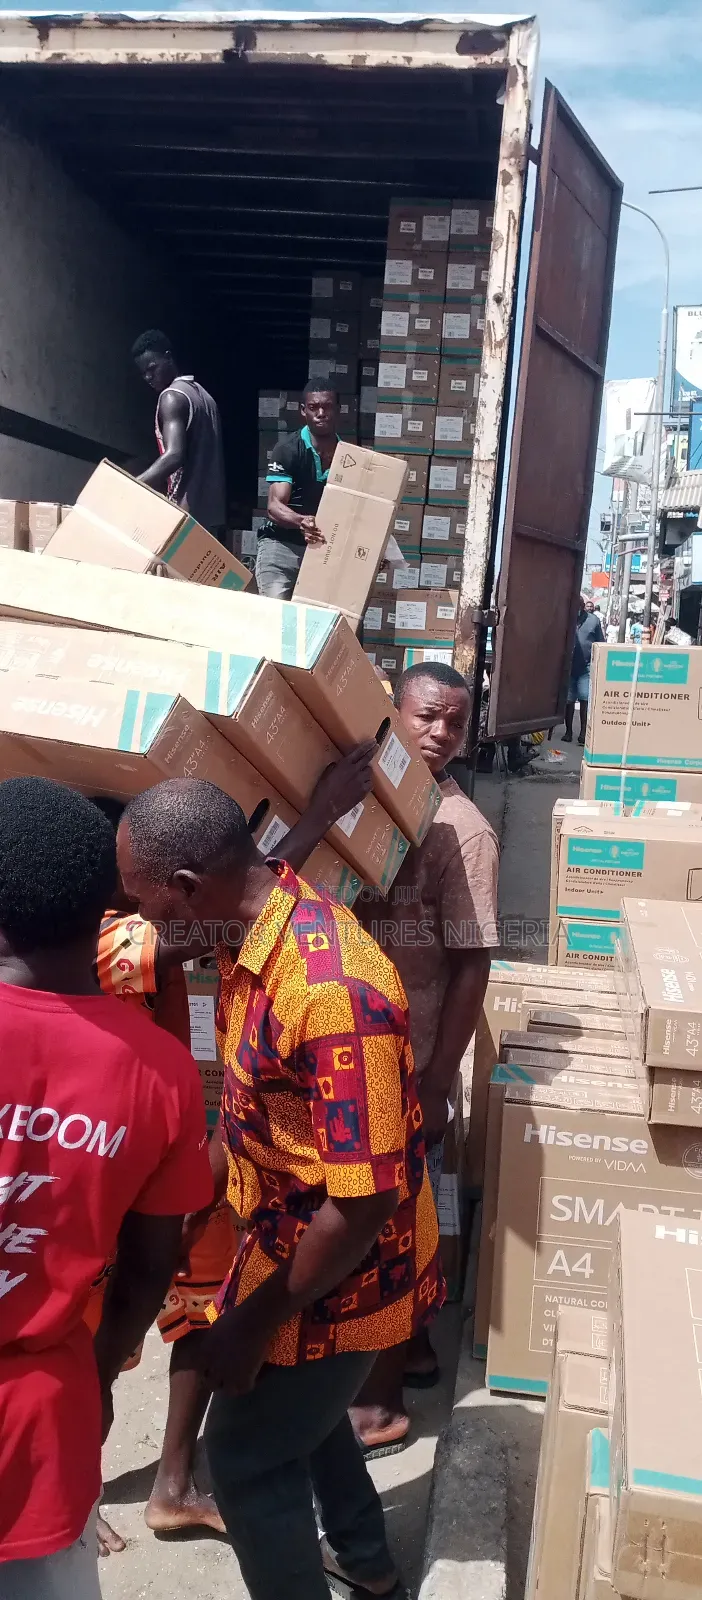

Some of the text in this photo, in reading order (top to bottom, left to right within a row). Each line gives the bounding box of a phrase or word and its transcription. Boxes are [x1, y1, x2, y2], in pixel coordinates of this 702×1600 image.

[603, 690, 690, 701] AIR CNDITIONER
[11, 697, 107, 728] Hisense
[164, 724, 191, 764] Hisense
[583, 868, 642, 878] CONDITIONER
[565, 952, 580, 960] AIR
[660, 968, 685, 1004] Hisense
[663, 1018, 672, 1056] Hisense
[685, 1021, 699, 1057] 43"A4
[667, 1076, 677, 1112] Hisense
[523, 1123, 649, 1155] Hisense
[568, 1155, 593, 1163] POWERED
[655, 1224, 702, 1246] Hi
[546, 1249, 594, 1279] A4
[545, 1295, 588, 1307] NATURAL
